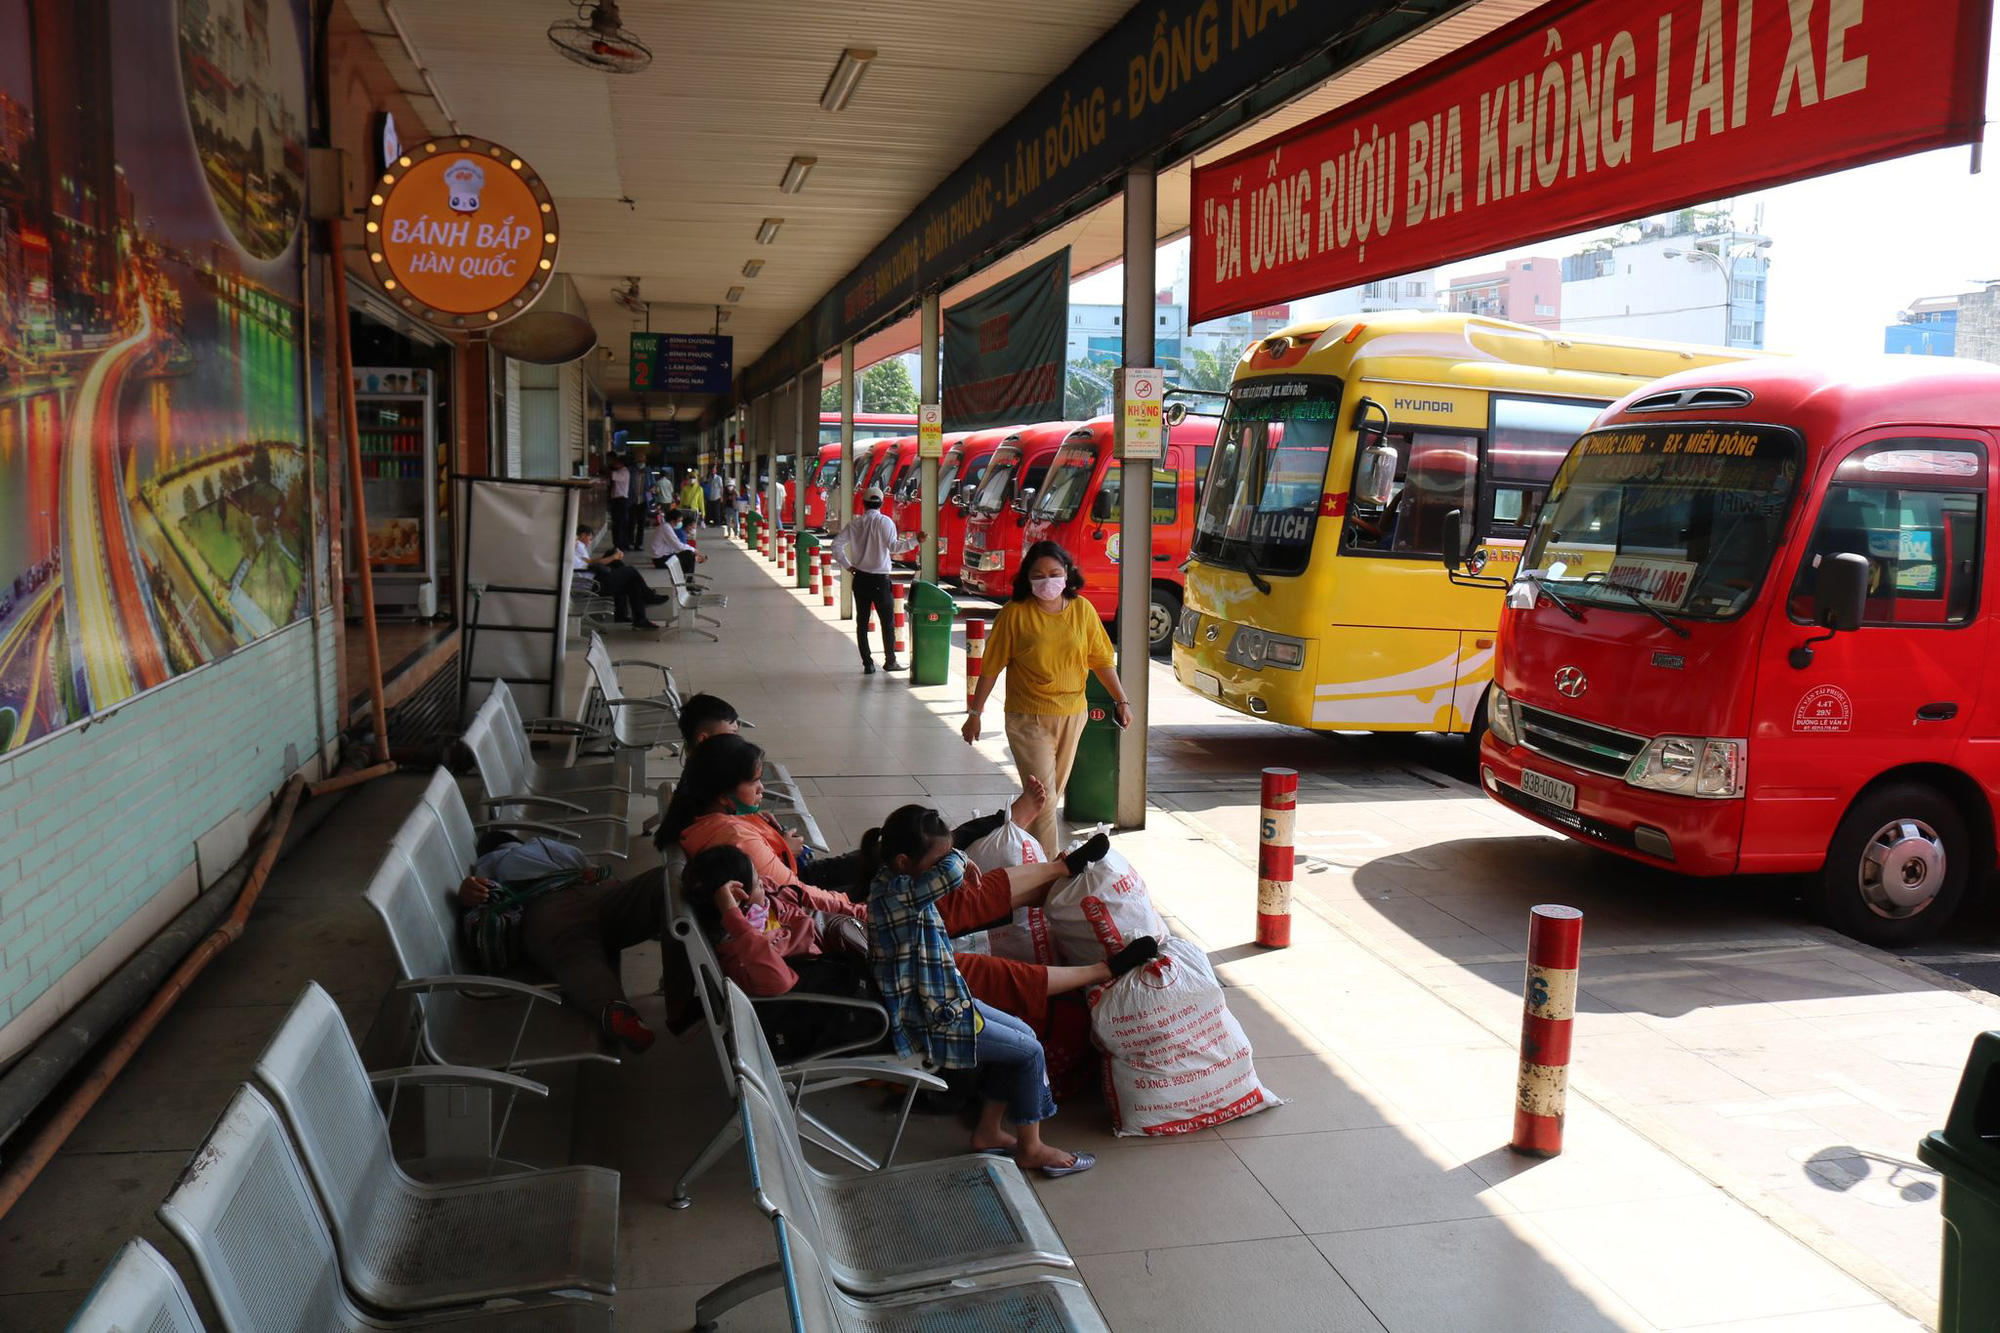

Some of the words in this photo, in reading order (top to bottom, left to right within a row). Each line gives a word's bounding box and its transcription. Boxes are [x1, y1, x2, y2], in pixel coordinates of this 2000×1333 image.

[924, 214, 949, 262] BÌNH
[950, 173, 993, 244] PHƯỚC
[1003, 140, 1040, 208] LÂM
[1045, 86, 1106, 180] ĐỒNG
[1127, 0, 1219, 121] ĐỒNG
[1250, 145, 1312, 275] UỐNG
[1318, 124, 1397, 263] RƯỢU
[1405, 105, 1463, 228] BIA
[1477, 27, 1636, 207] KHÔNG
[1771, 0, 1869, 117] XE
[390, 214, 470, 248] BÁNH
[476, 215, 531, 250] BẮP
[409, 250, 455, 274] HÀN
[459, 252, 517, 279] QUỐC
[635, 361, 649, 385] 2
[1127, 402, 1159, 418] KHÔNG
[1394, 398, 1454, 413] HYUNDAI
[1616, 434, 1647, 454] LONG
[1684, 429, 1721, 454] MIỀN
[1716, 430, 1759, 457] ĐÔNG
[1270, 514, 1310, 545] LỊCH
[1649, 569, 1689, 604] LONG
[1092, 710, 1101, 719] 11
[1523, 771, 1573, 805] 93B-004.74
[1262, 817, 1277, 840] 5
[1530, 976, 1549, 1007] 6
[1134, 1075, 1147, 1090] SỐ
[1239, 1094, 1260, 1112] NAM
